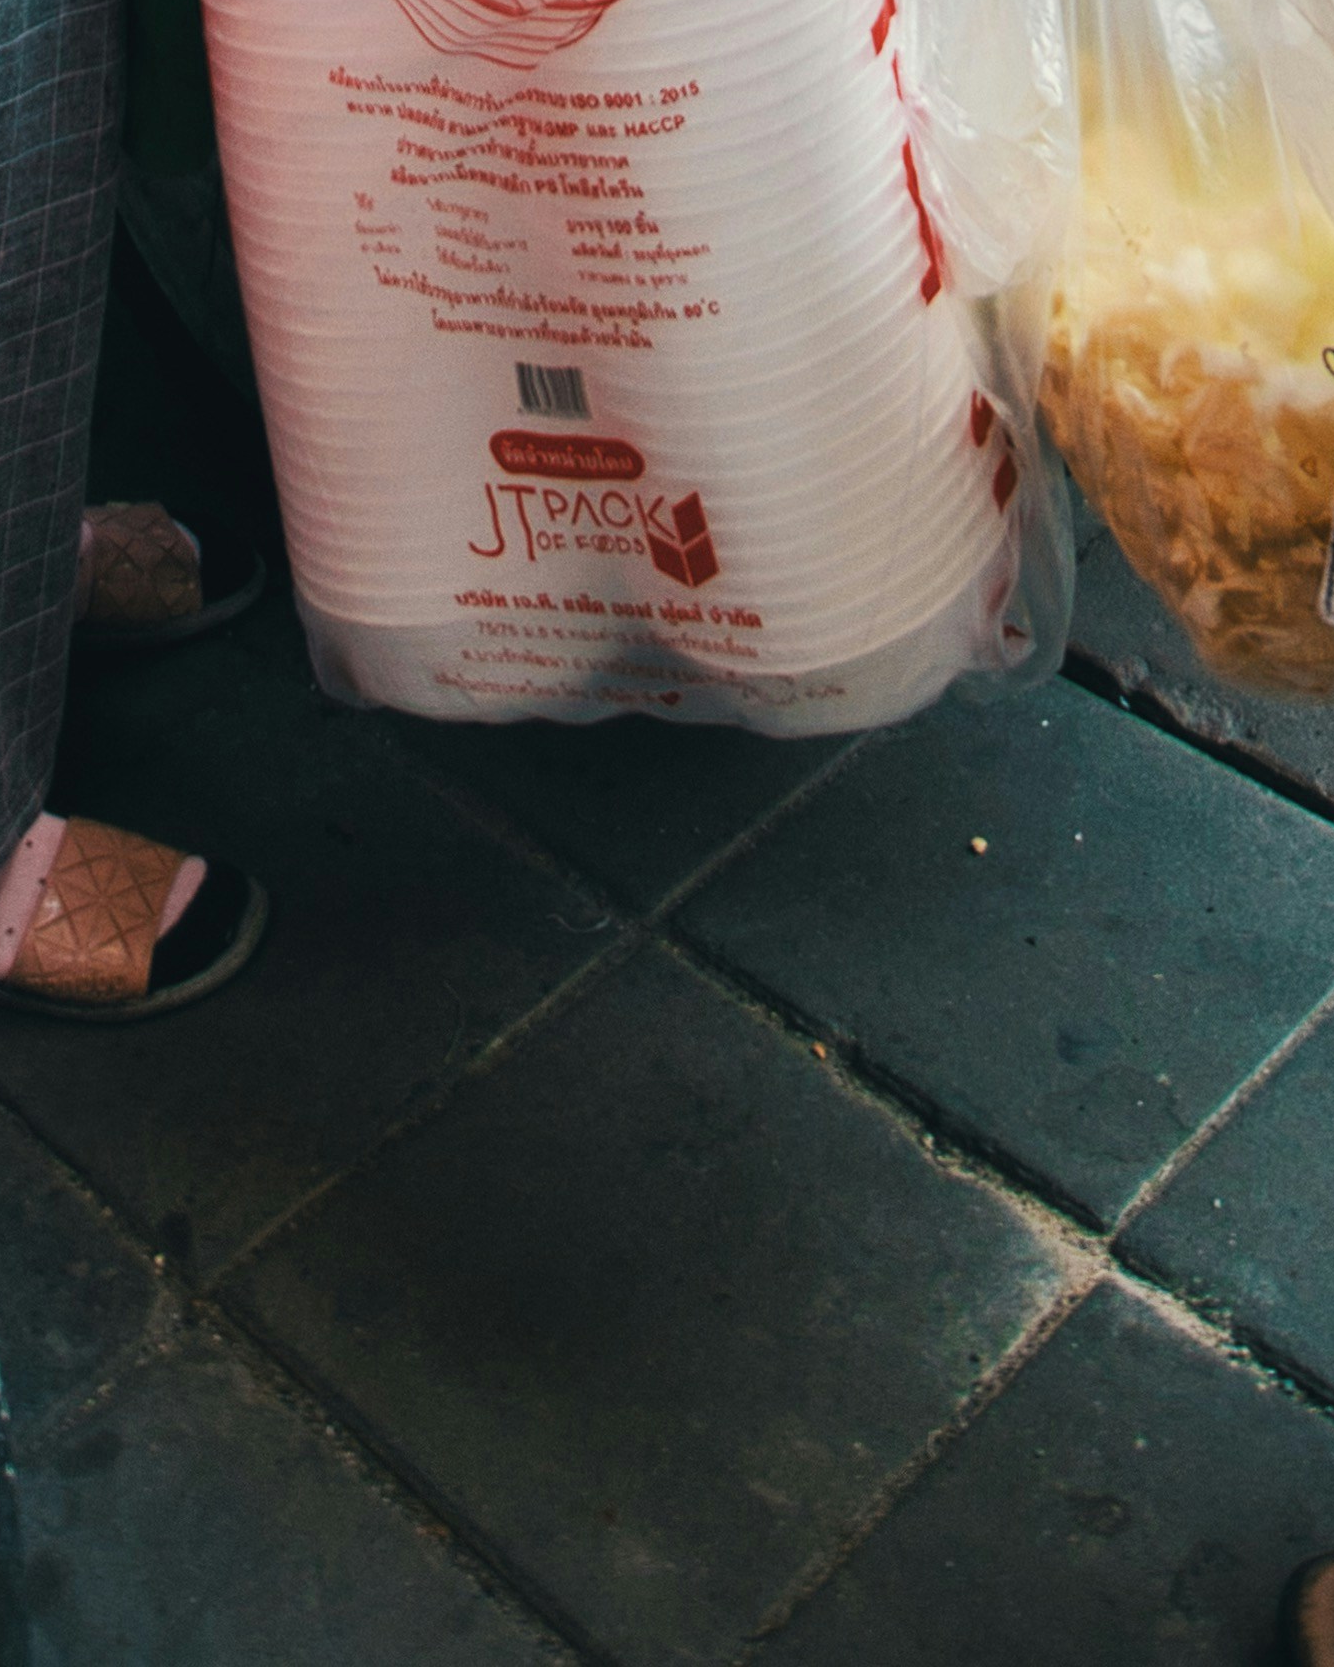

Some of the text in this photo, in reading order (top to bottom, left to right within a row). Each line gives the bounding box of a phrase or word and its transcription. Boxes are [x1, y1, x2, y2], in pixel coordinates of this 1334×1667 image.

[569, 93, 600, 110] ISO
[659, 79, 700, 106] 2015
[623, 113, 686, 138] HACCP
[467, 482, 677, 562] JT PACK
